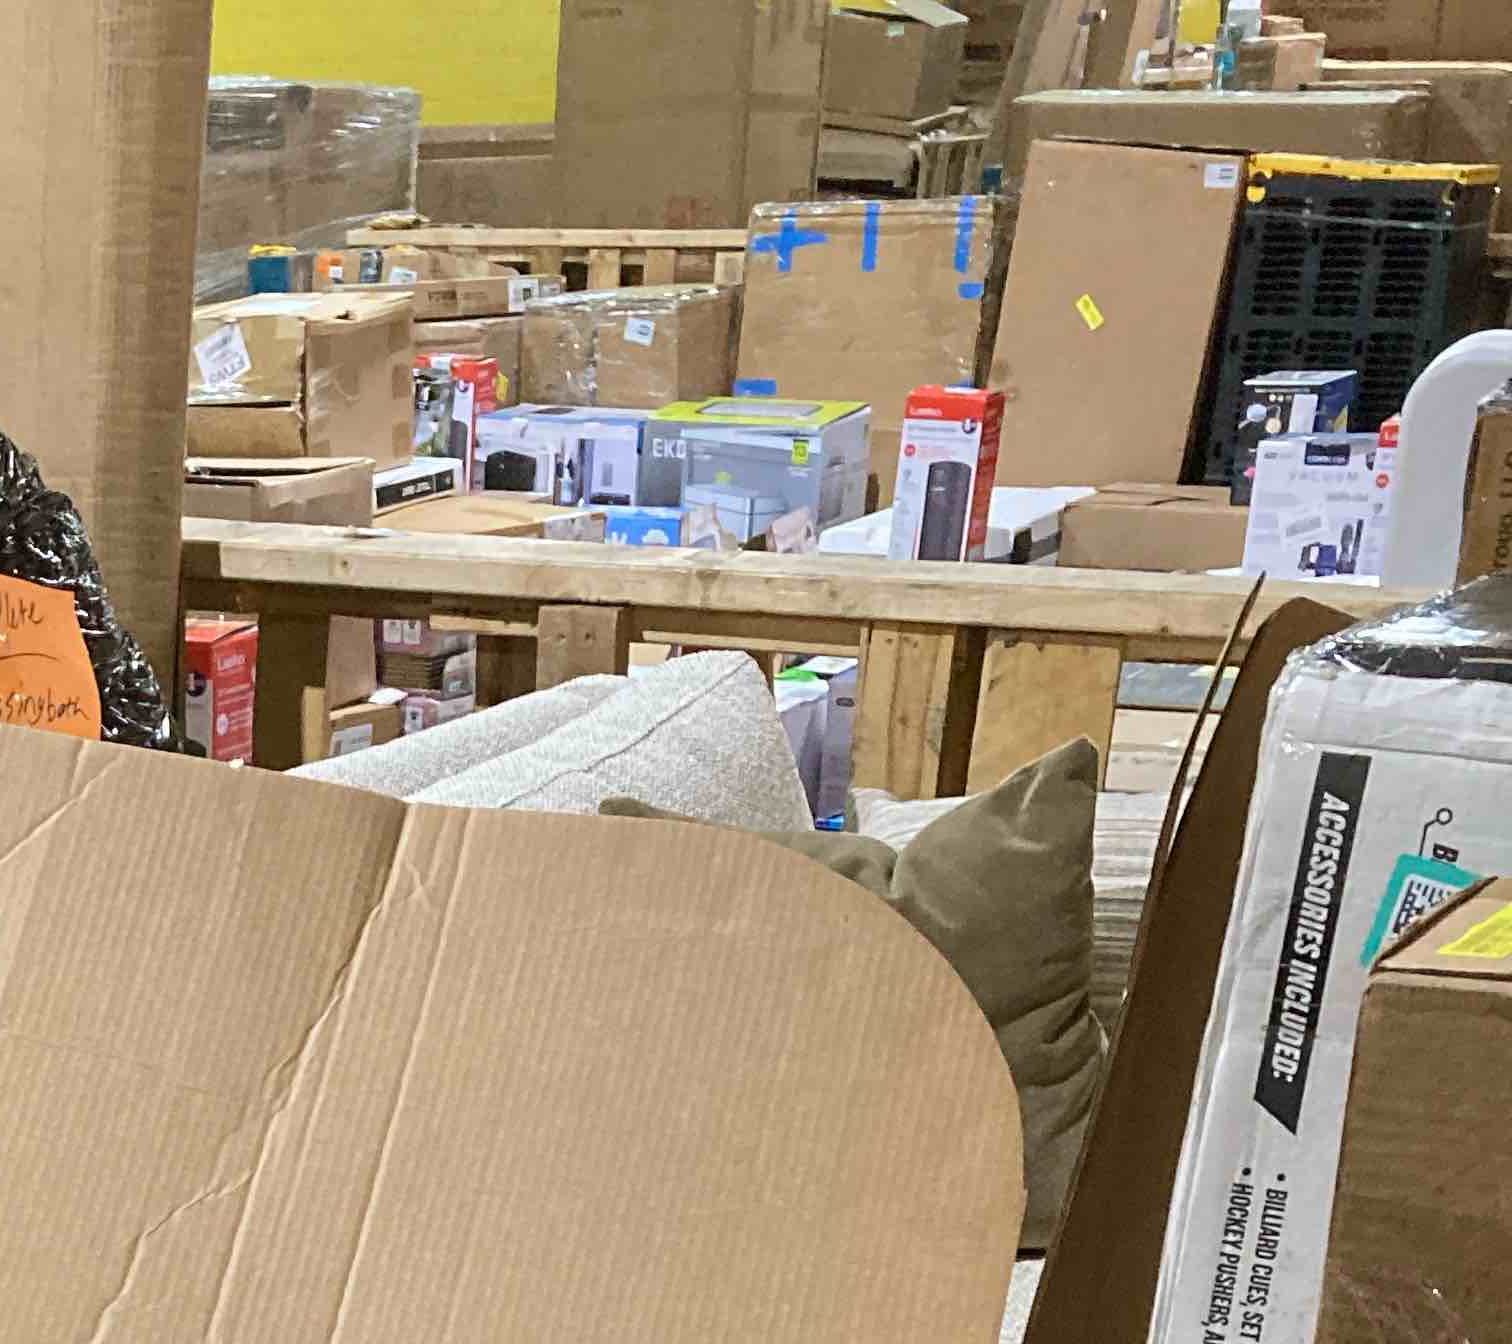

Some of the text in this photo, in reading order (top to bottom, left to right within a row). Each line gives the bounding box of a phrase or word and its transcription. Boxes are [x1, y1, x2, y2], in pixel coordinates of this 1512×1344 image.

[1266, 792, 1352, 1081] ACCESSORIES INCLUDED:
[1220, 1181, 1253, 1249] HOCKEY
[1253, 1187, 1289, 1261] BILLIARD
[1202, 1250, 1241, 1330] PUSHERS,
[1240, 1261, 1273, 1309] CUES,
[1239, 1309, 1264, 1342] SET
